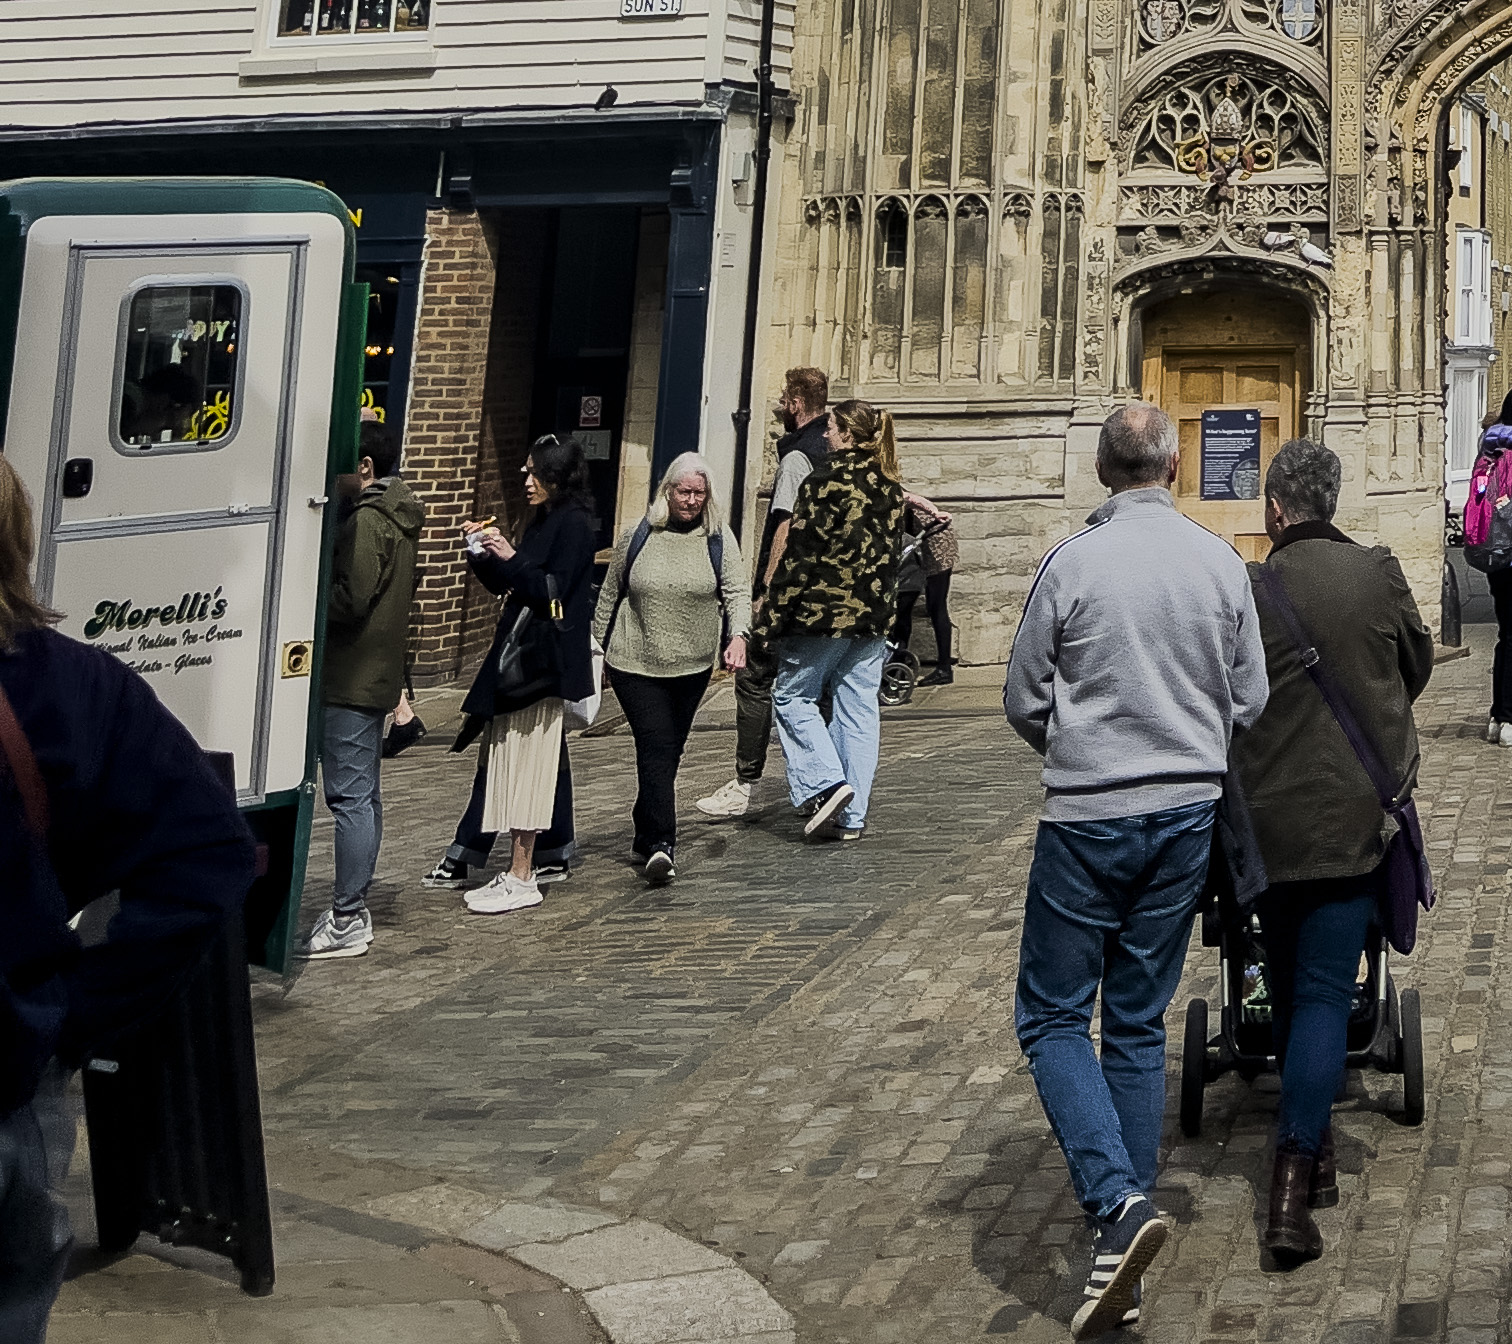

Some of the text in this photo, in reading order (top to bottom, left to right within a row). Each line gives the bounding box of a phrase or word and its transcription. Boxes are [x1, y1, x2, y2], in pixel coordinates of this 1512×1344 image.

[84, 585, 229, 640] Morelli's
[137, 632, 178, 652] Italian
[182, 623, 243, 646] Ice-Cream
[174, 653, 213, 676] Glaces
